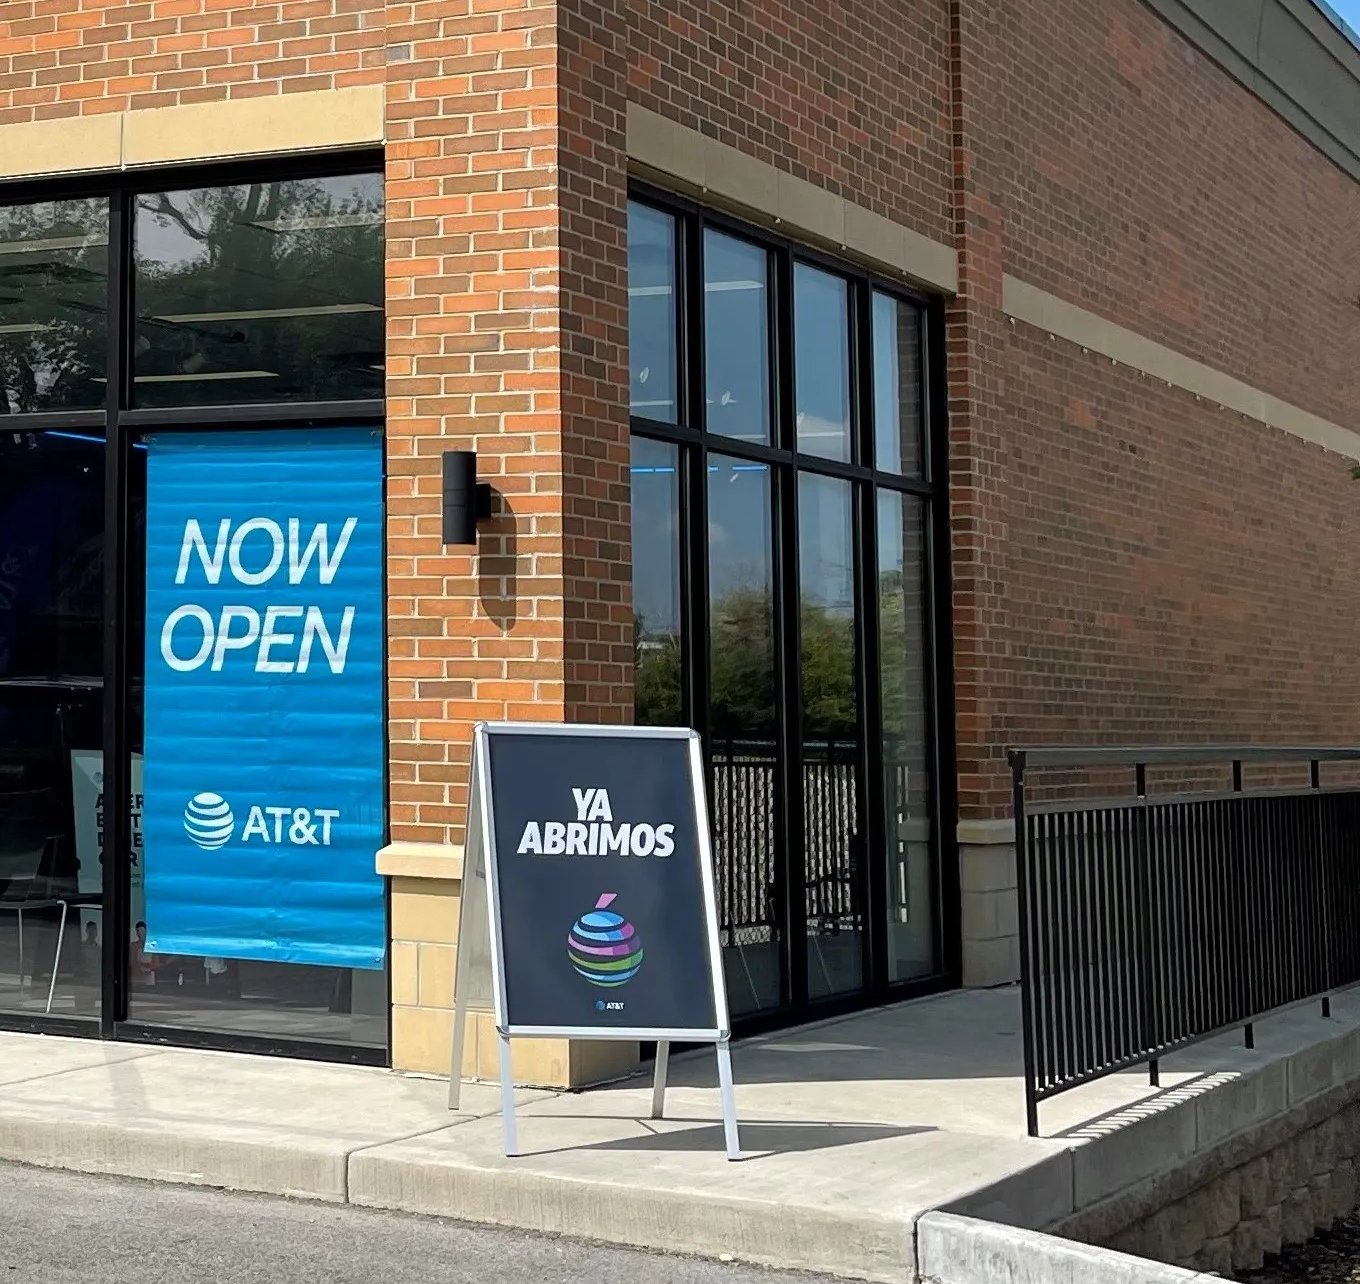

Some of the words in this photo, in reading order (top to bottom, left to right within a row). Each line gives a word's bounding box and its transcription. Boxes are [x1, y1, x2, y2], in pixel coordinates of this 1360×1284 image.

[174, 516, 358, 586] NOW
[160, 604, 356, 674] OPEN
[572, 788, 614, 822] YA
[241, 805, 340, 845] AT&T
[516, 821, 676, 858] ABRIMOS
[606, 1001, 625, 1010] AT&T
